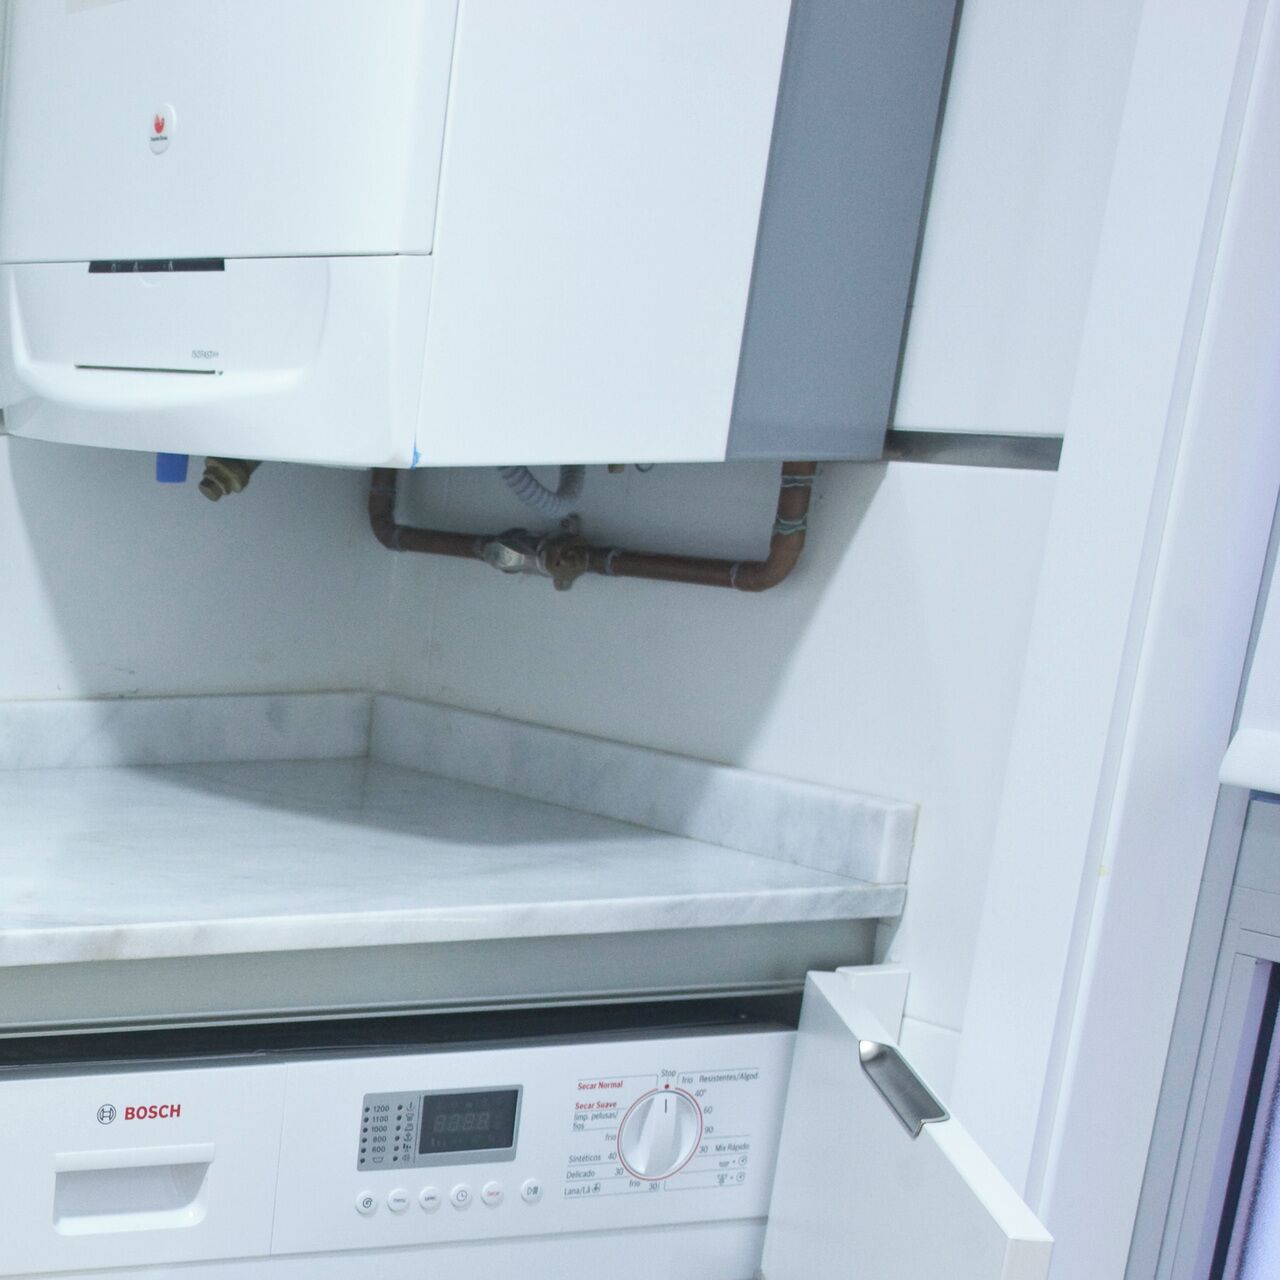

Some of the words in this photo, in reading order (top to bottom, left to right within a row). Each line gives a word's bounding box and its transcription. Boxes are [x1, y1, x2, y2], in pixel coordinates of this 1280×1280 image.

[661, 1069, 676, 1079] Stop
[578, 1082, 597, 1090] Secar
[598, 1080, 623, 1089] Normal
[575, 1102, 595, 1110] Secar
[596, 1101, 617, 1109] Suave
[703, 1106, 713, 1114] 60
[124, 1104, 181, 1120] BOSCH
[704, 1126, 714, 1134] 90
[699, 1145, 708, 1153] 30
[715, 1143, 726, 1152] Mix
[569, 1153, 601, 1163] Sintéticos
[608, 1152, 617, 1160] 40
[566, 1168, 595, 1179] Delicado
[615, 1168, 624, 1176] 30
